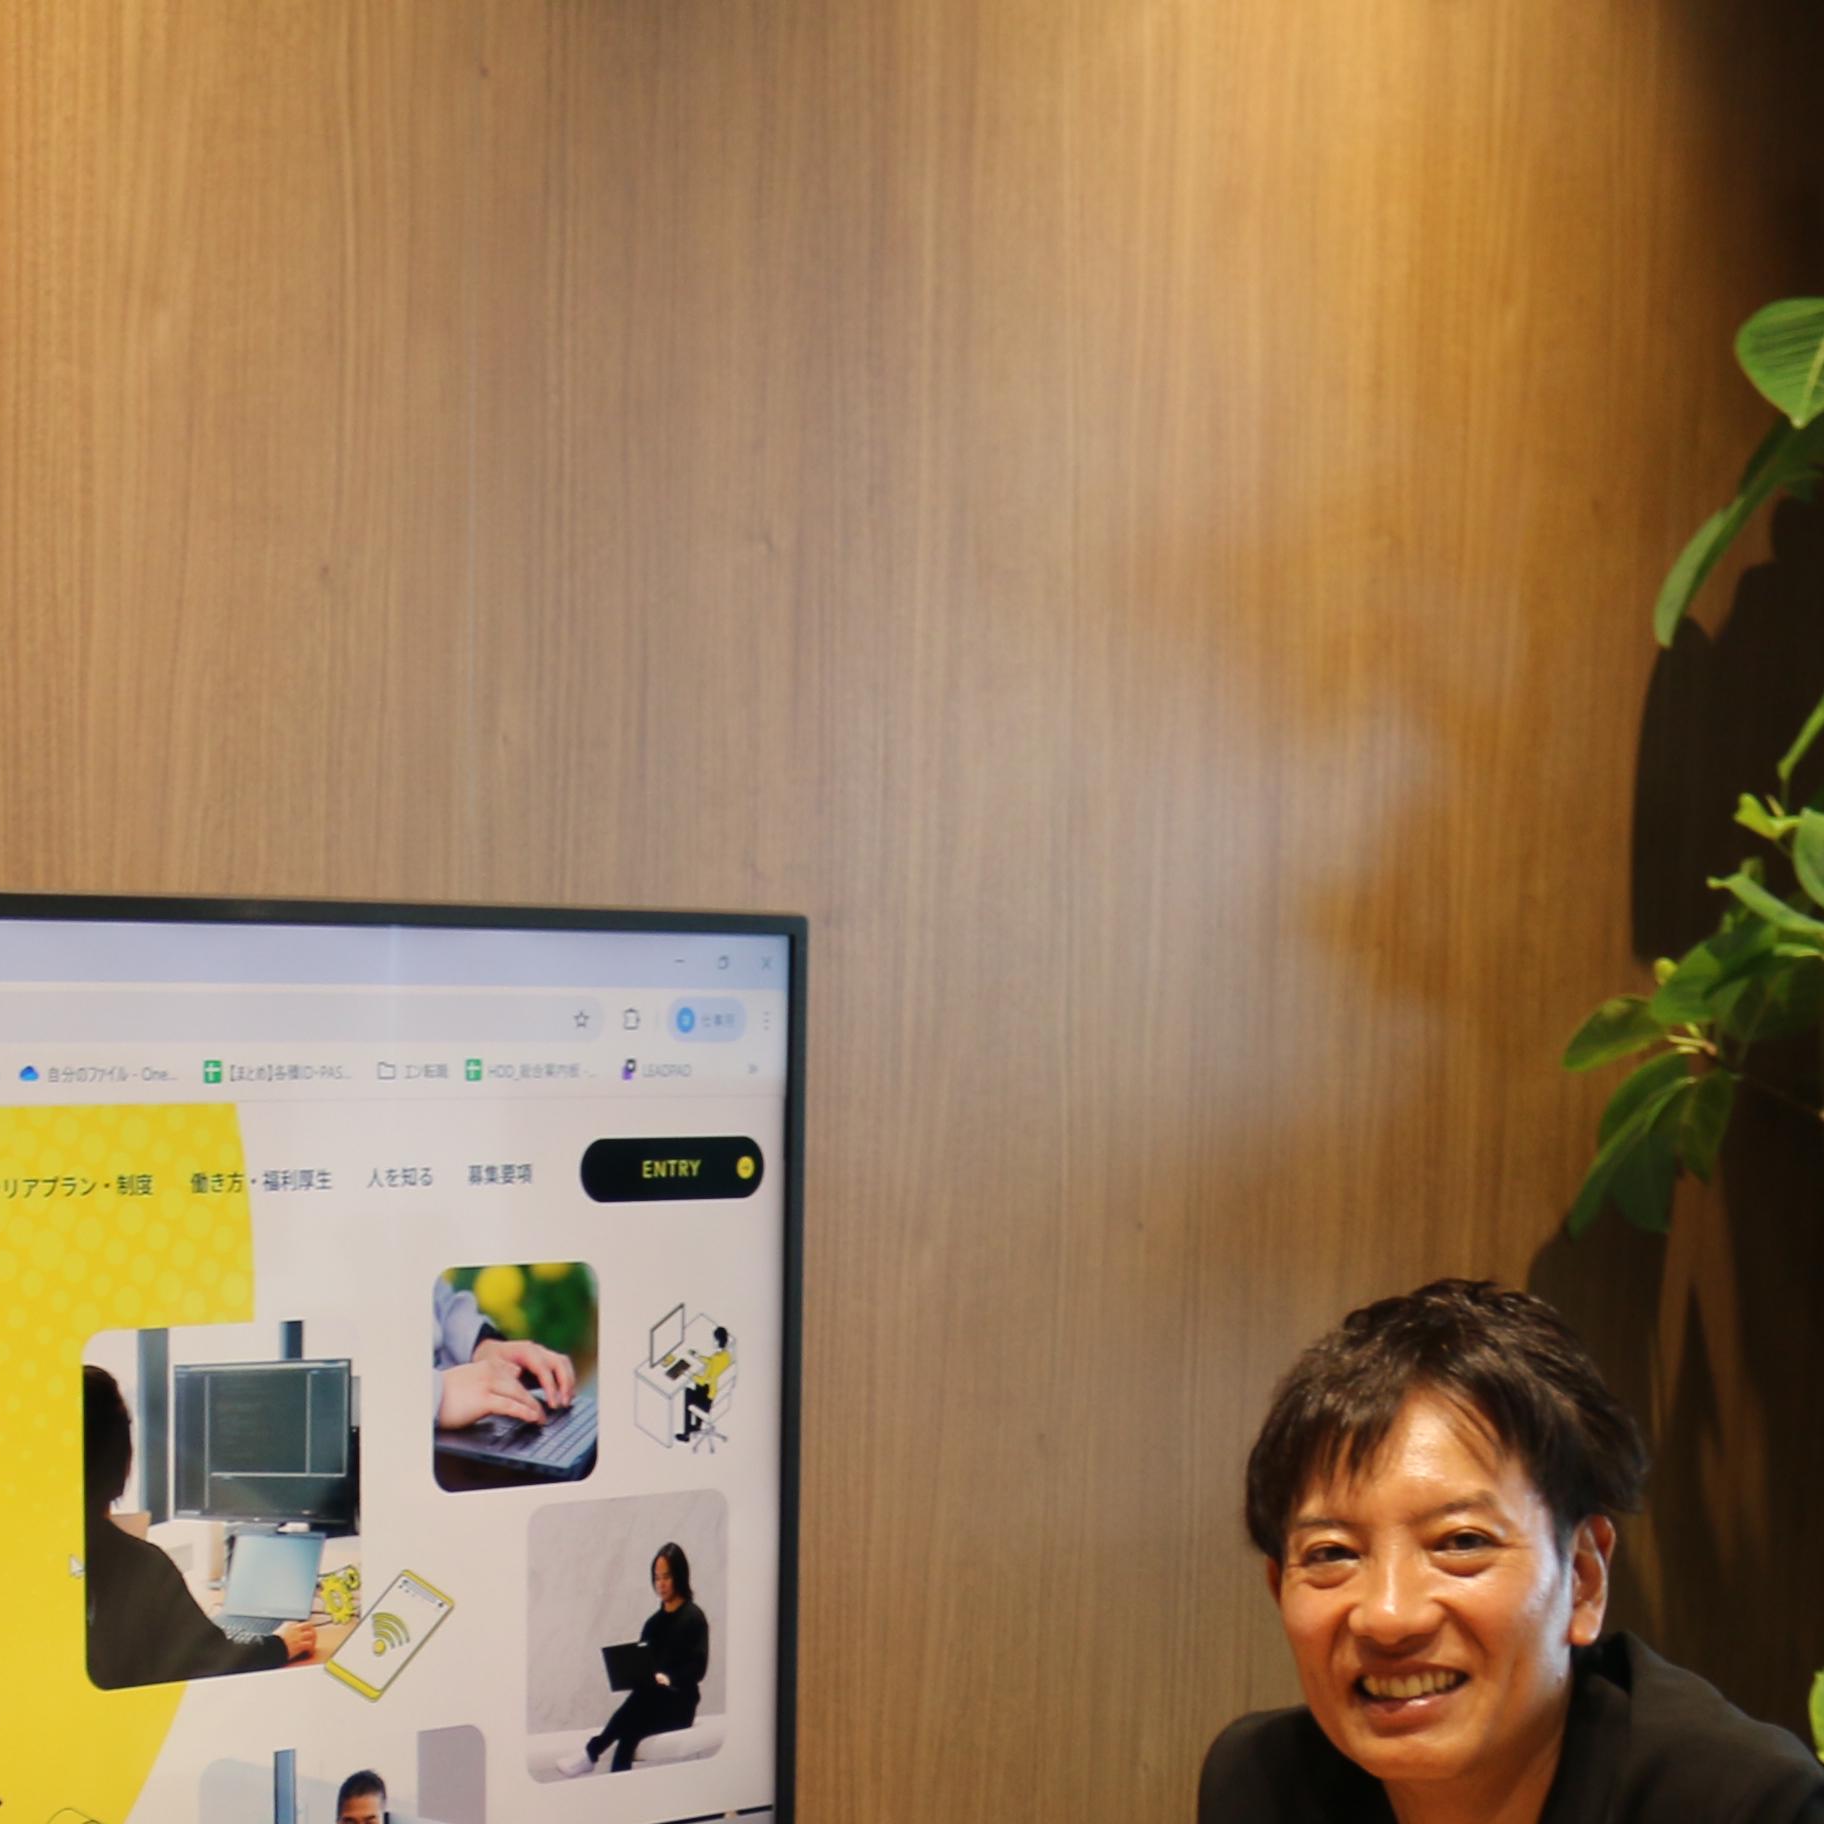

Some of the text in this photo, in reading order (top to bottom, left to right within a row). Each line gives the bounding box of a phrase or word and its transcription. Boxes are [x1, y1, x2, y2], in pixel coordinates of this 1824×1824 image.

[190, 1168, 333, 1195] 働き方・福利厚生
[366, 1165, 434, 1189] 人を知る
[467, 1162, 534, 1186] 募集要項
[640, 1159, 702, 1181] ENTRY
